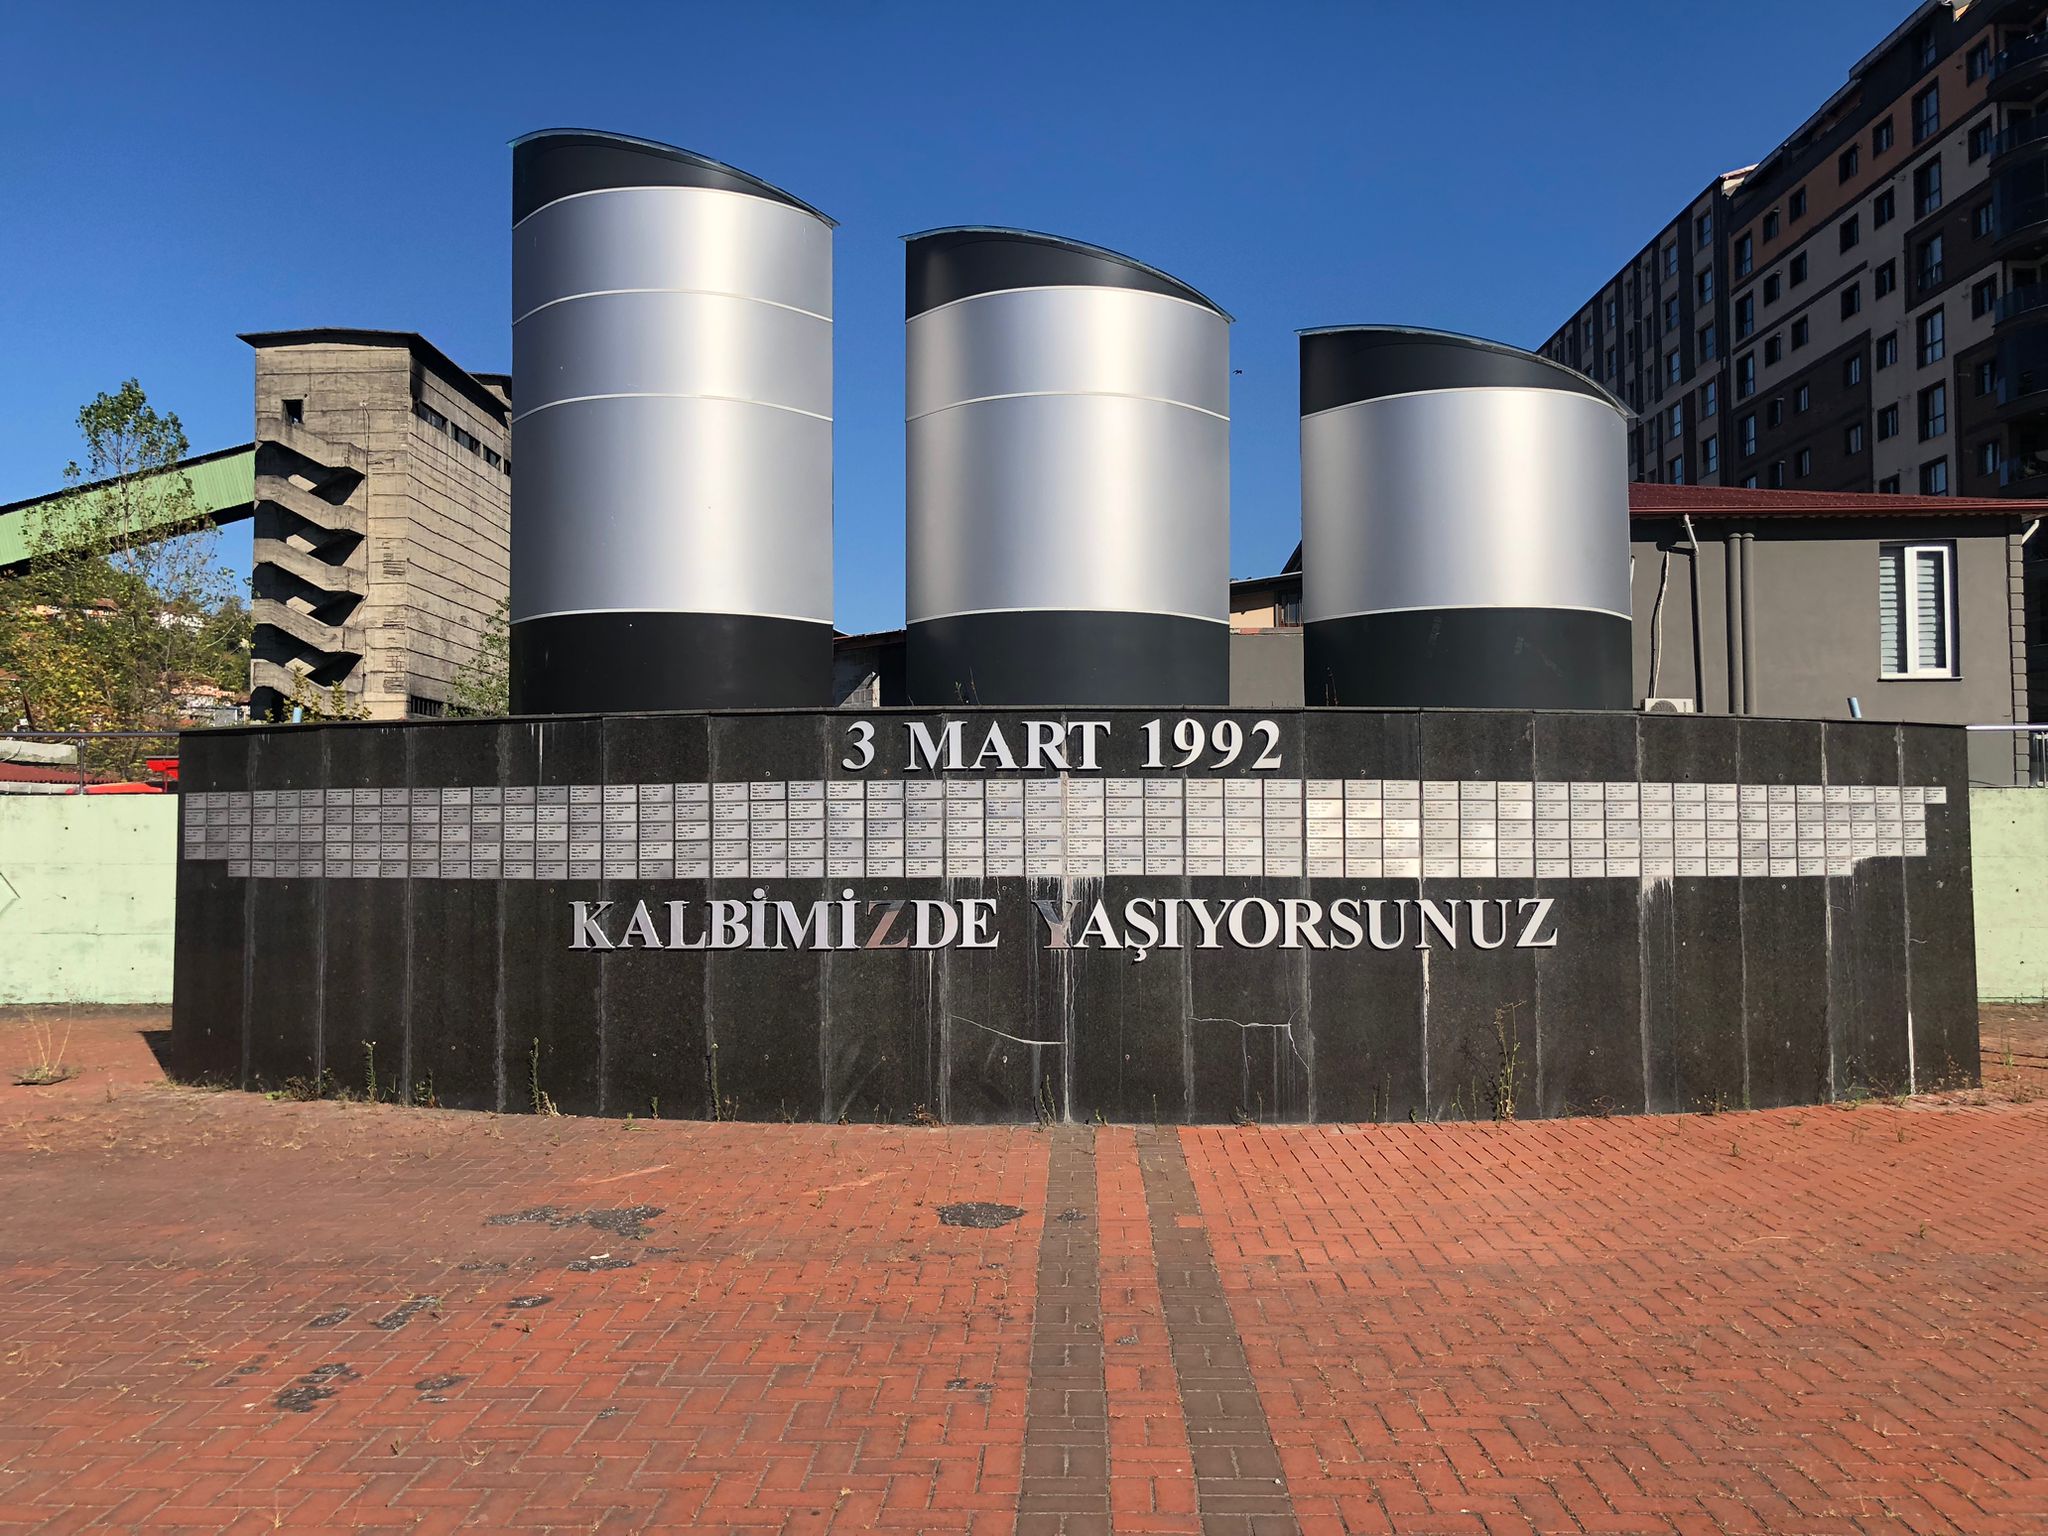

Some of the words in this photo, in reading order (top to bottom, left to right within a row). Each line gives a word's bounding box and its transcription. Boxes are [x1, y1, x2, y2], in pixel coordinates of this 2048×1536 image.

[842, 720, 875, 770] 3
[903, 720, 1111, 770] MART
[1141, 719, 1283, 769] 1992
[569, 888, 1000, 950] KALBİMİZDE
[1031, 897, 1558, 962] YAŞIYORSUNUZ
